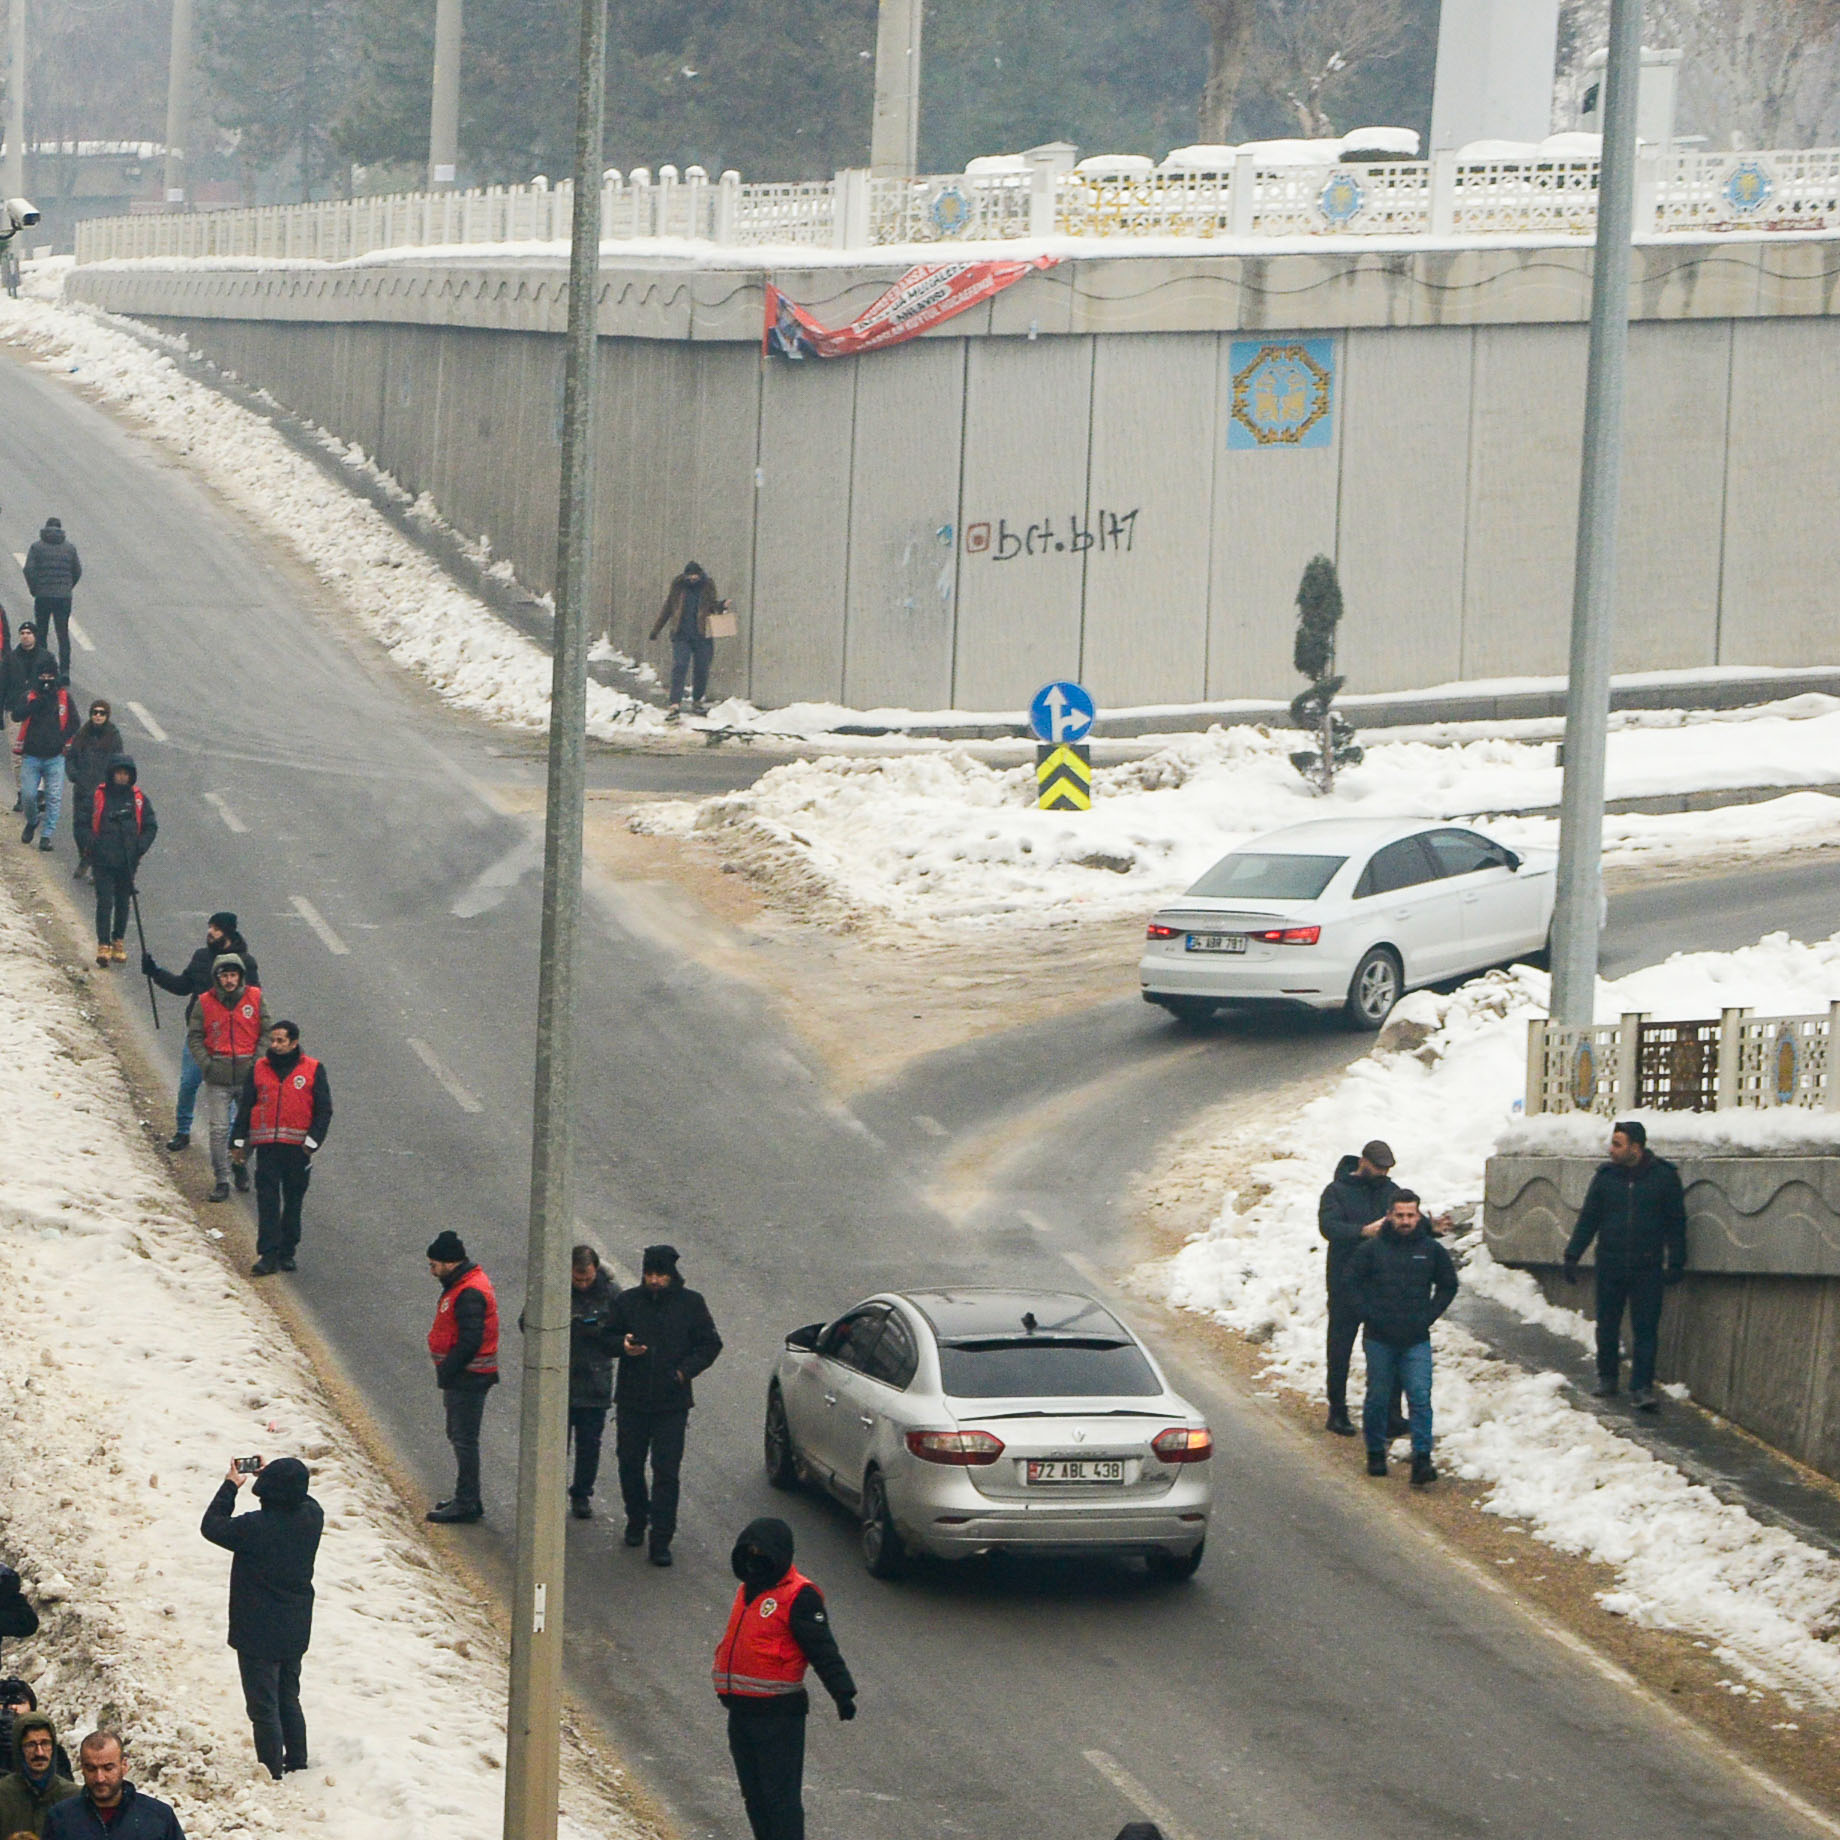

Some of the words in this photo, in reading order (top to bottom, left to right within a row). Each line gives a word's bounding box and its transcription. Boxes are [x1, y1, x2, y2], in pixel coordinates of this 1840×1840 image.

[1037, 1463, 1055, 1478] 72
[1060, 1463, 1087, 1478] ABL
[1093, 1462, 1121, 1478] 438
